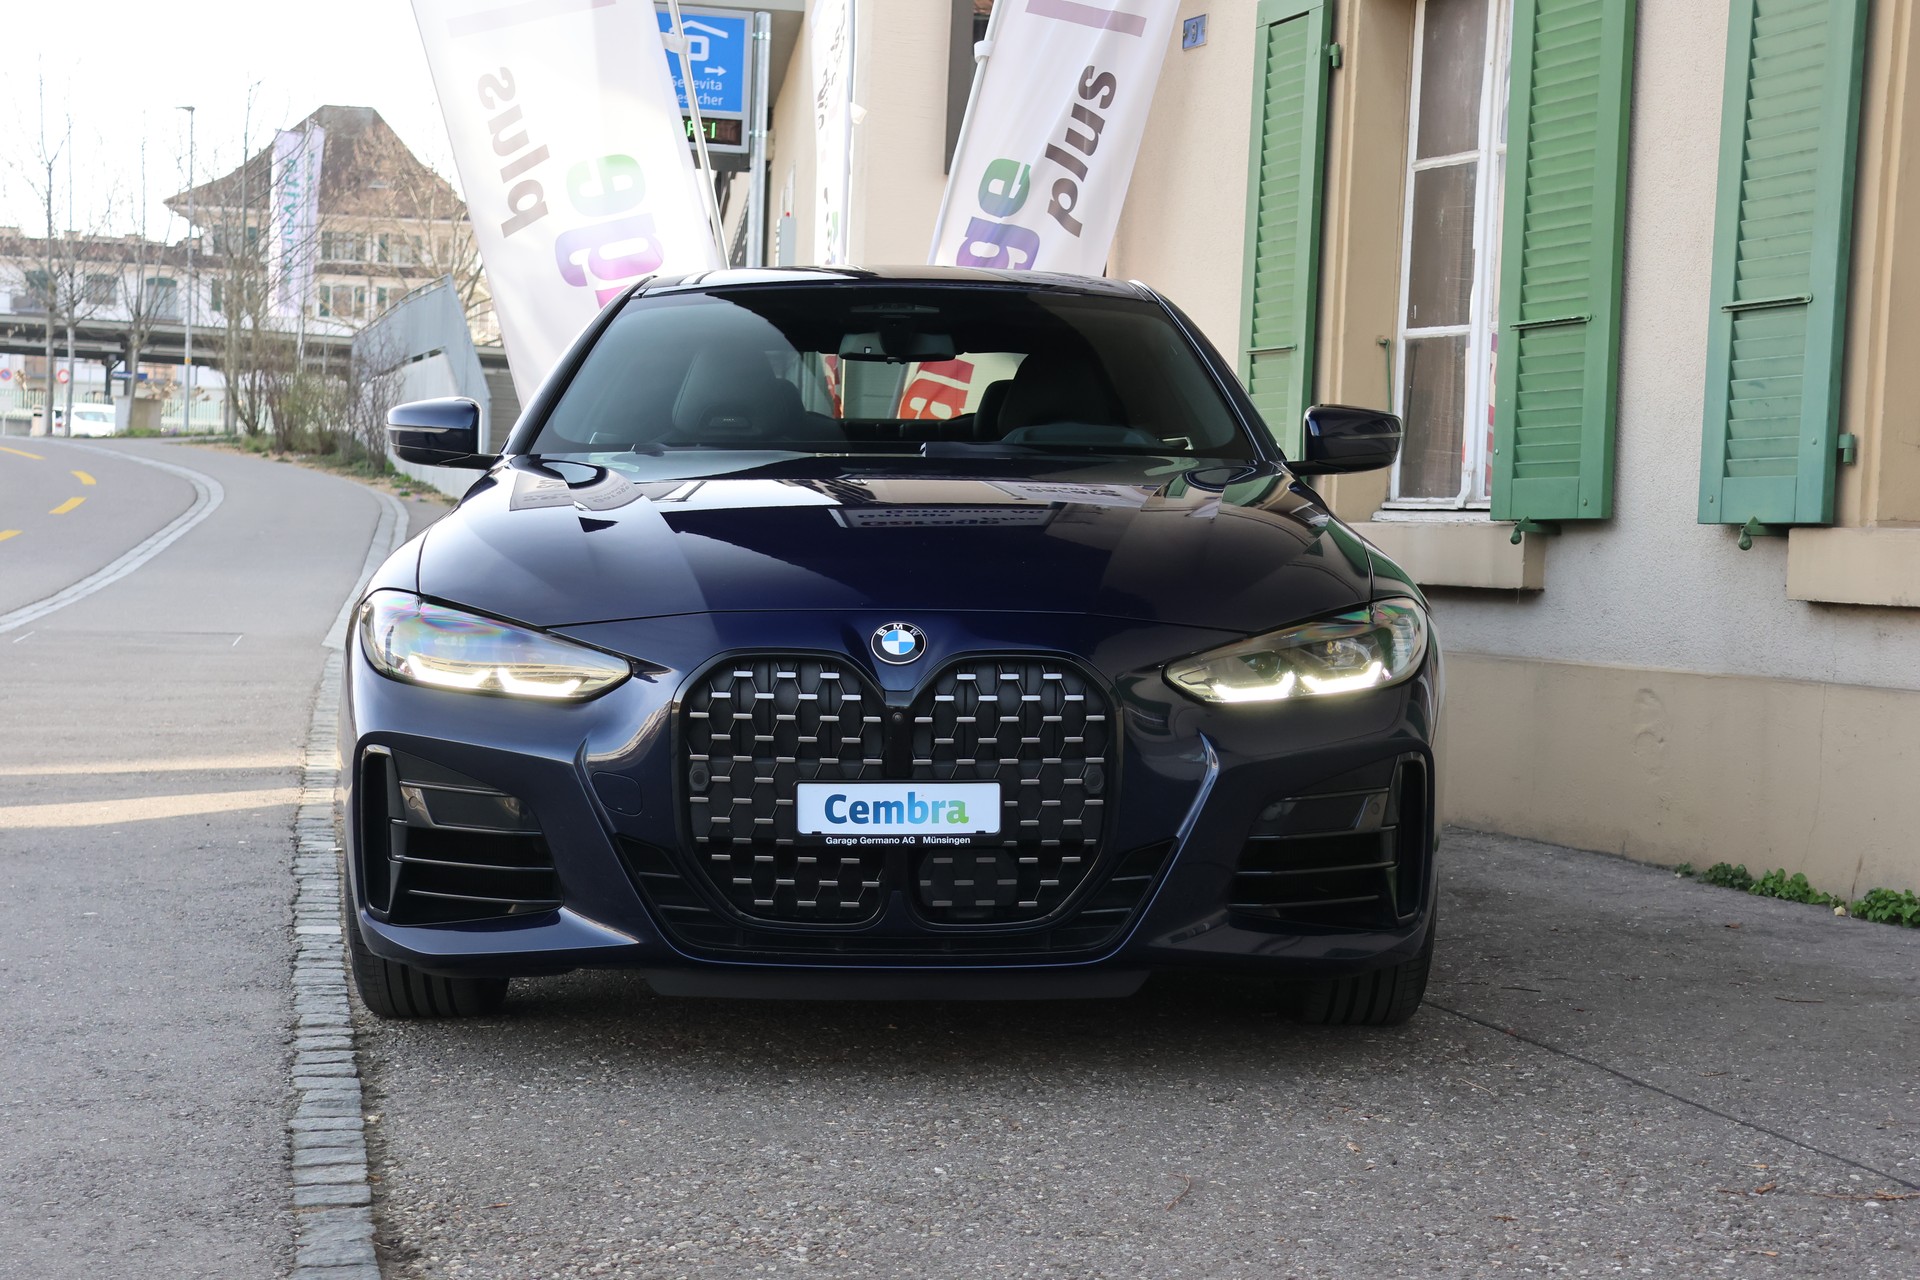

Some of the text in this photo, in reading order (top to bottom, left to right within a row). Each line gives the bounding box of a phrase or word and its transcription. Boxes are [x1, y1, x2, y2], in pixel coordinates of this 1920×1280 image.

[672, 75, 723, 91] Seevita
[1044, 65, 1117, 238] plus
[876, 623, 922, 637] BMW
[824, 792, 969, 825] Cembra
[826, 836, 970, 845] Garage Germano AG Münsingen
